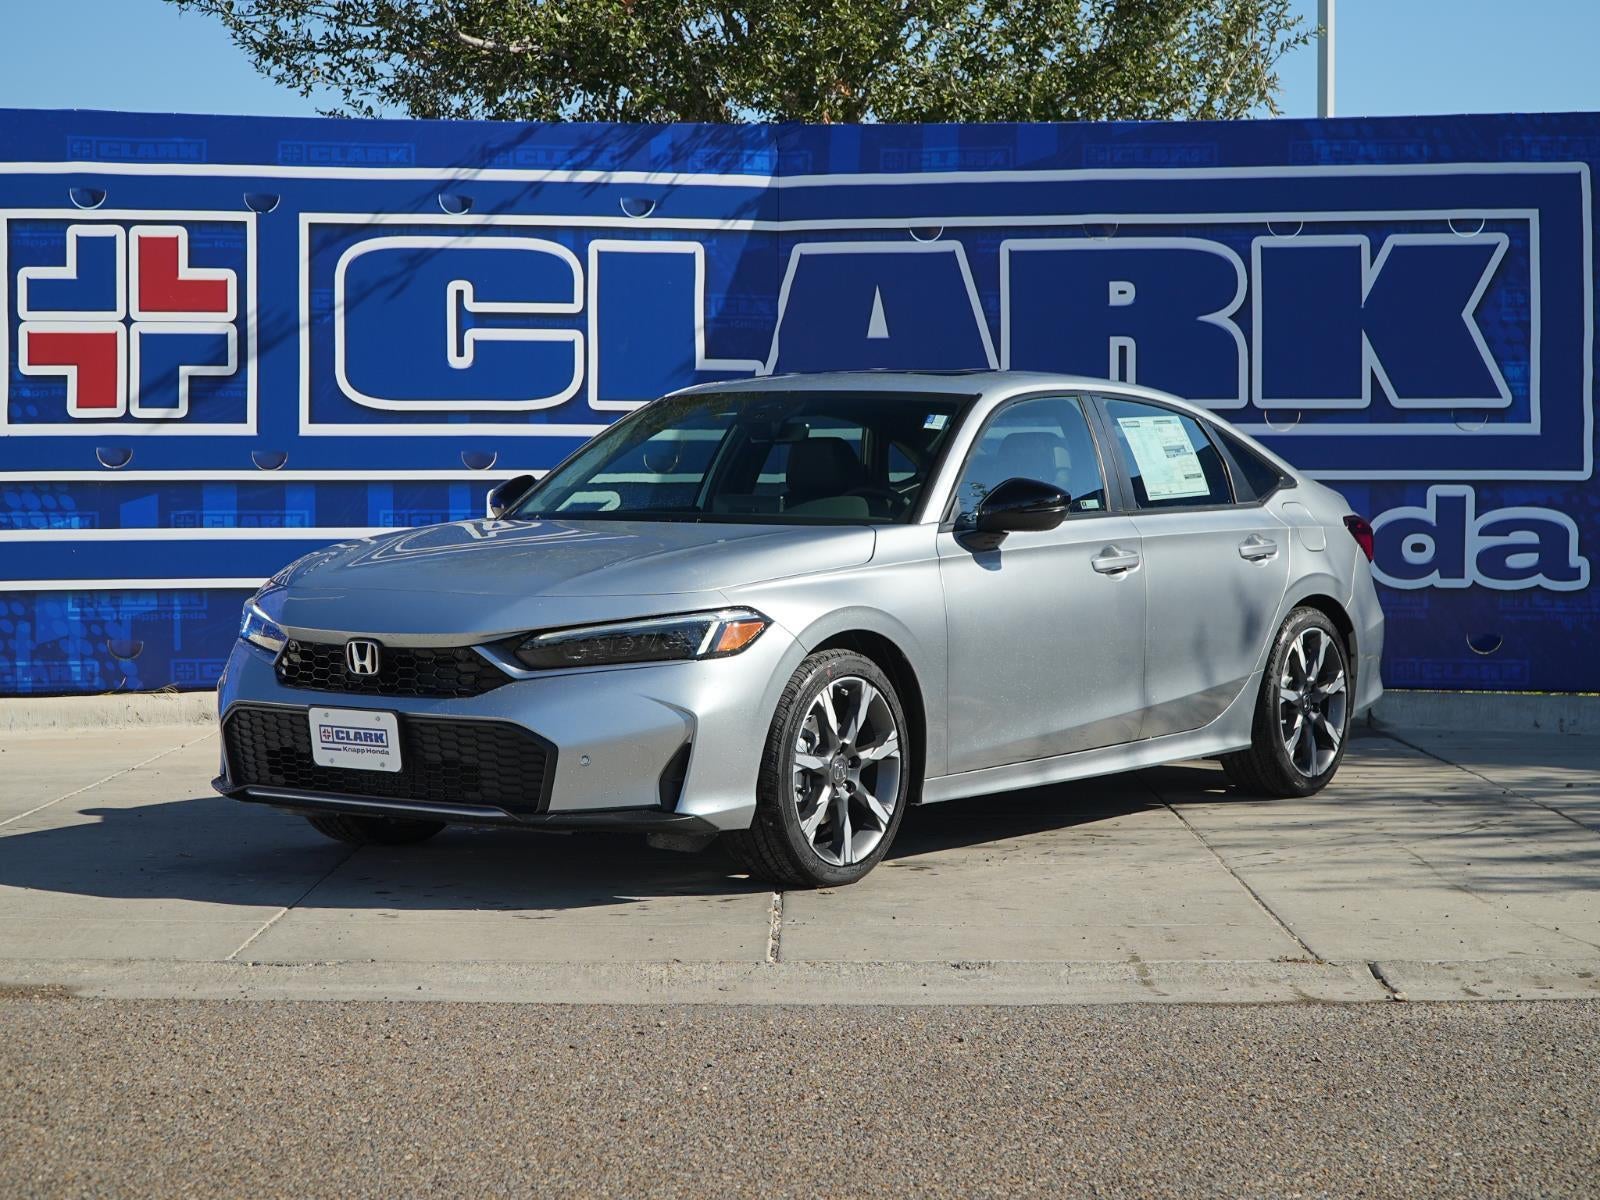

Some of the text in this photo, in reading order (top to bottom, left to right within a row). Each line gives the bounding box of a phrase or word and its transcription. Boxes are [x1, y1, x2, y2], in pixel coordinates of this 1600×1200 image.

[99, 142, 202, 159] CLARK
[312, 144, 408, 161] CLARK
[335, 234, 1512, 411] CLARK
[334, 729, 385, 744] CLARK
[342, 745, 390, 756] Knapp Honda
